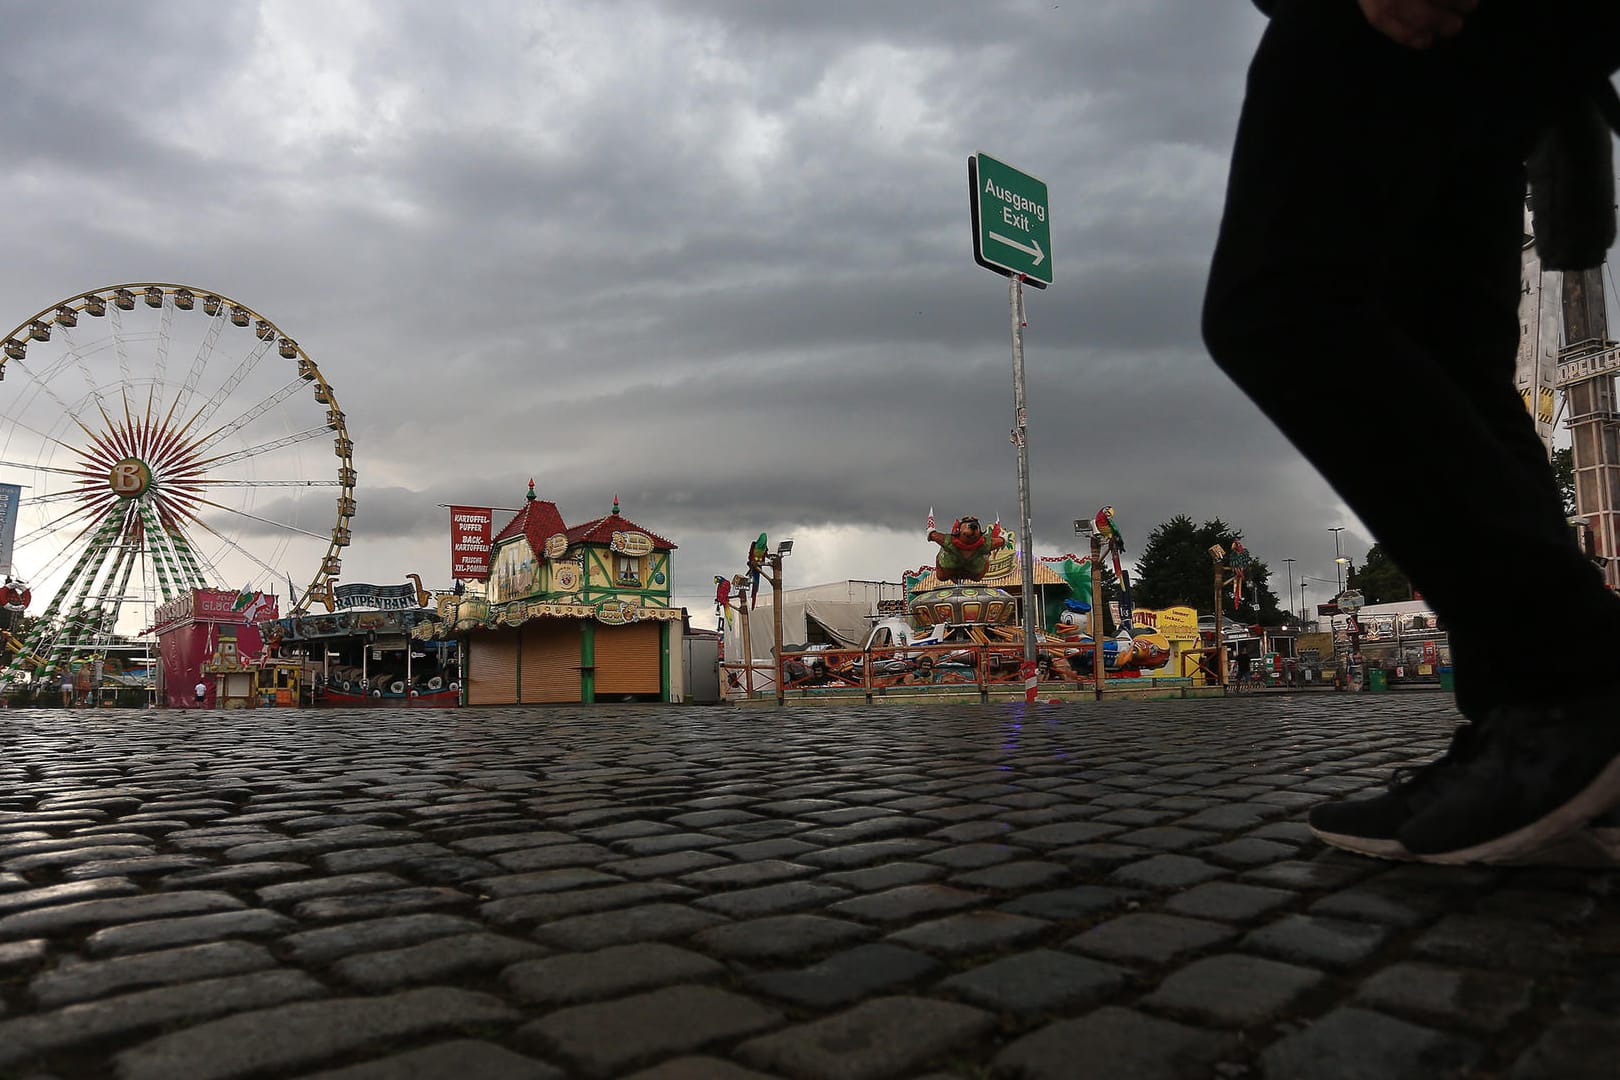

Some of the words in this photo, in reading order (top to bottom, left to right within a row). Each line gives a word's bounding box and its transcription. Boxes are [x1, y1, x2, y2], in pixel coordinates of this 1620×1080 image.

[985, 178, 1045, 221] Ausgang
[1003, 207, 1030, 232] Exit
[114, 464, 141, 494] B
[454, 515, 490, 523] KARTOFFEL-
[459, 523, 482, 532] PUFFER
[462, 536, 484, 544] BACK-
[455, 544, 489, 552] KARTOFFELN
[335, 595, 418, 611] RAUPENBAHN
